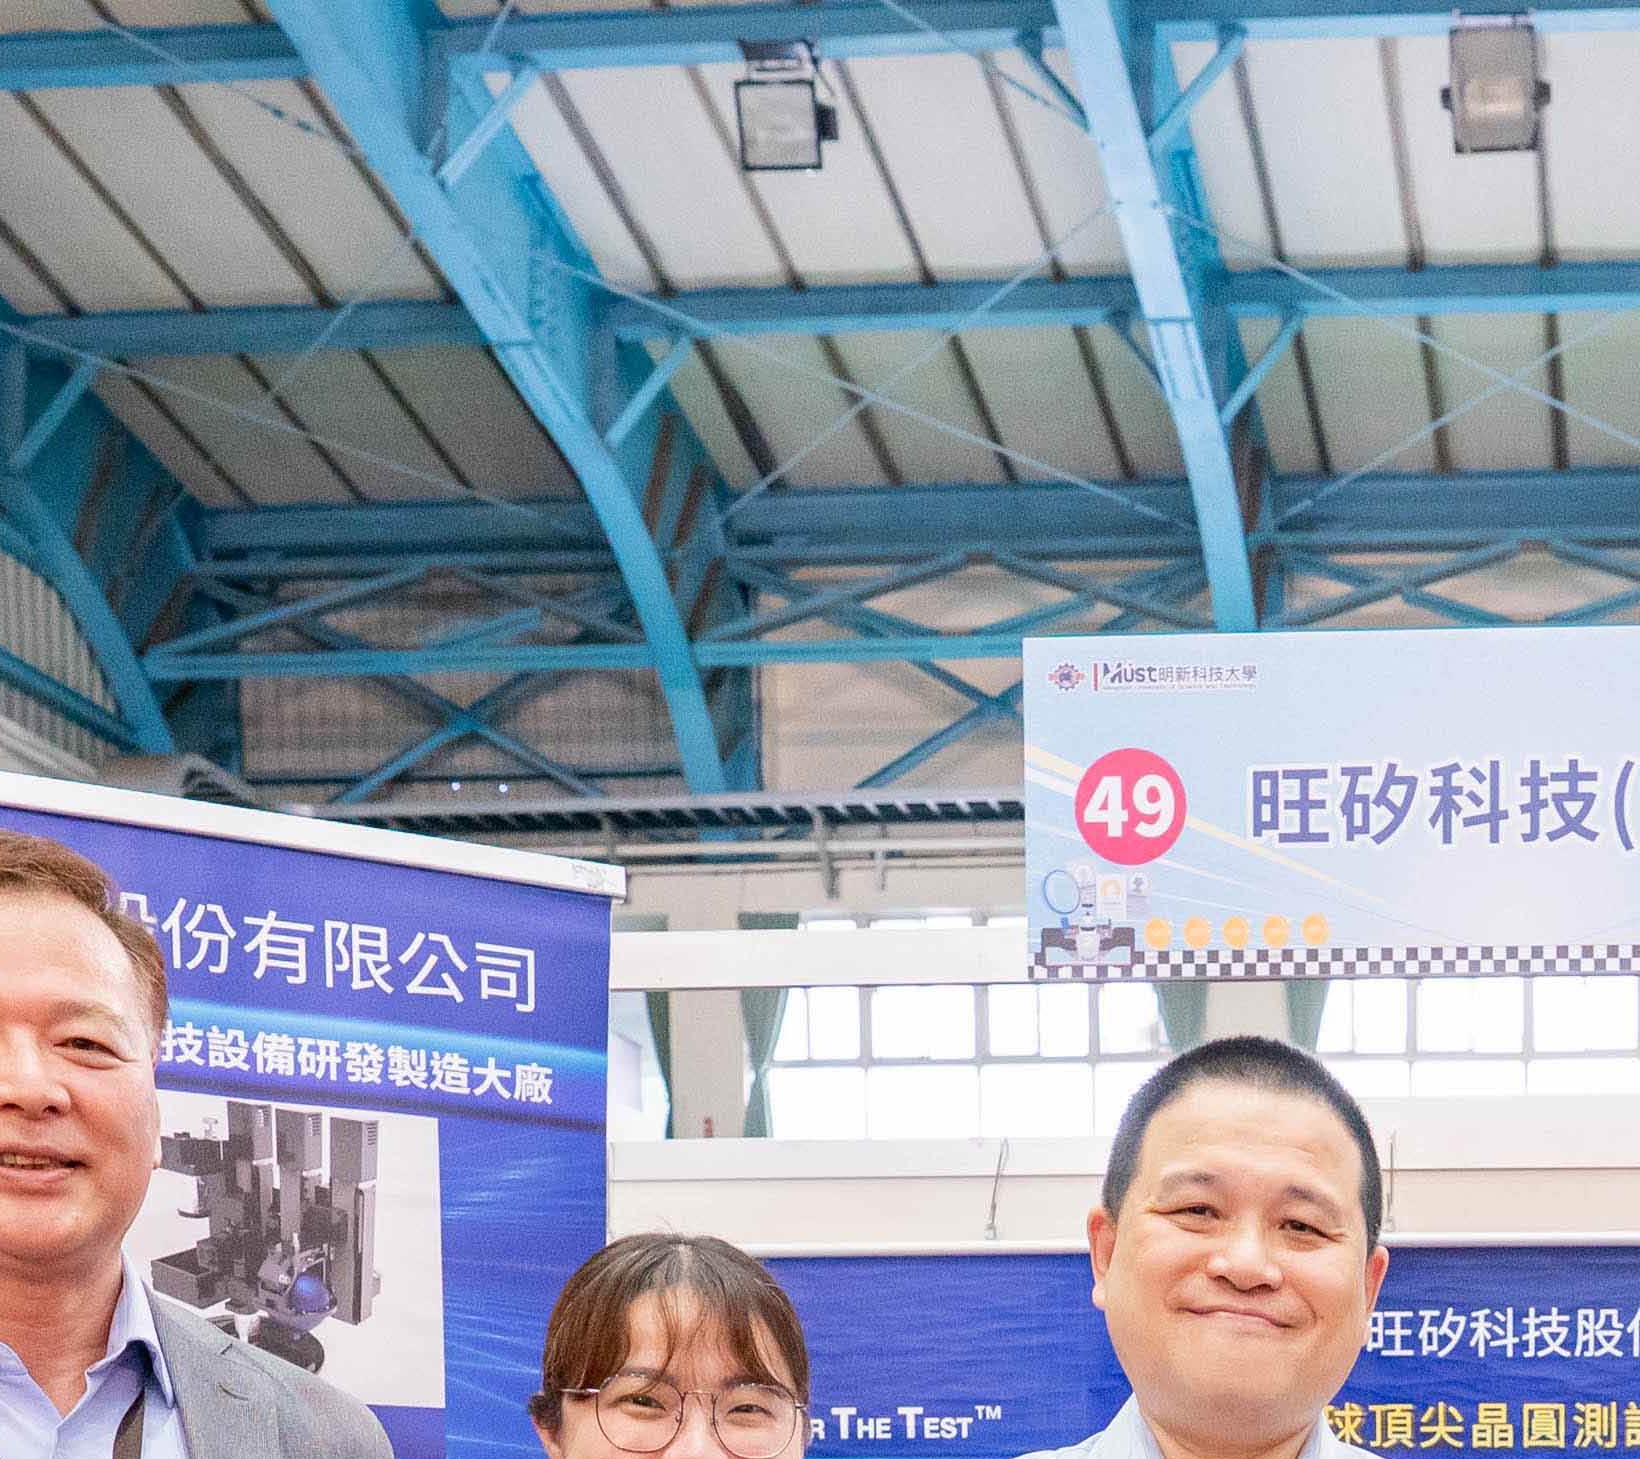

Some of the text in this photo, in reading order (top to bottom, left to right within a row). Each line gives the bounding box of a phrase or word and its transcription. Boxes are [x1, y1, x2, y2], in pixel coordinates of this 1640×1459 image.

[1159, 664, 1257, 683] 明新科技大學
[1083, 774, 1176, 829] 49
